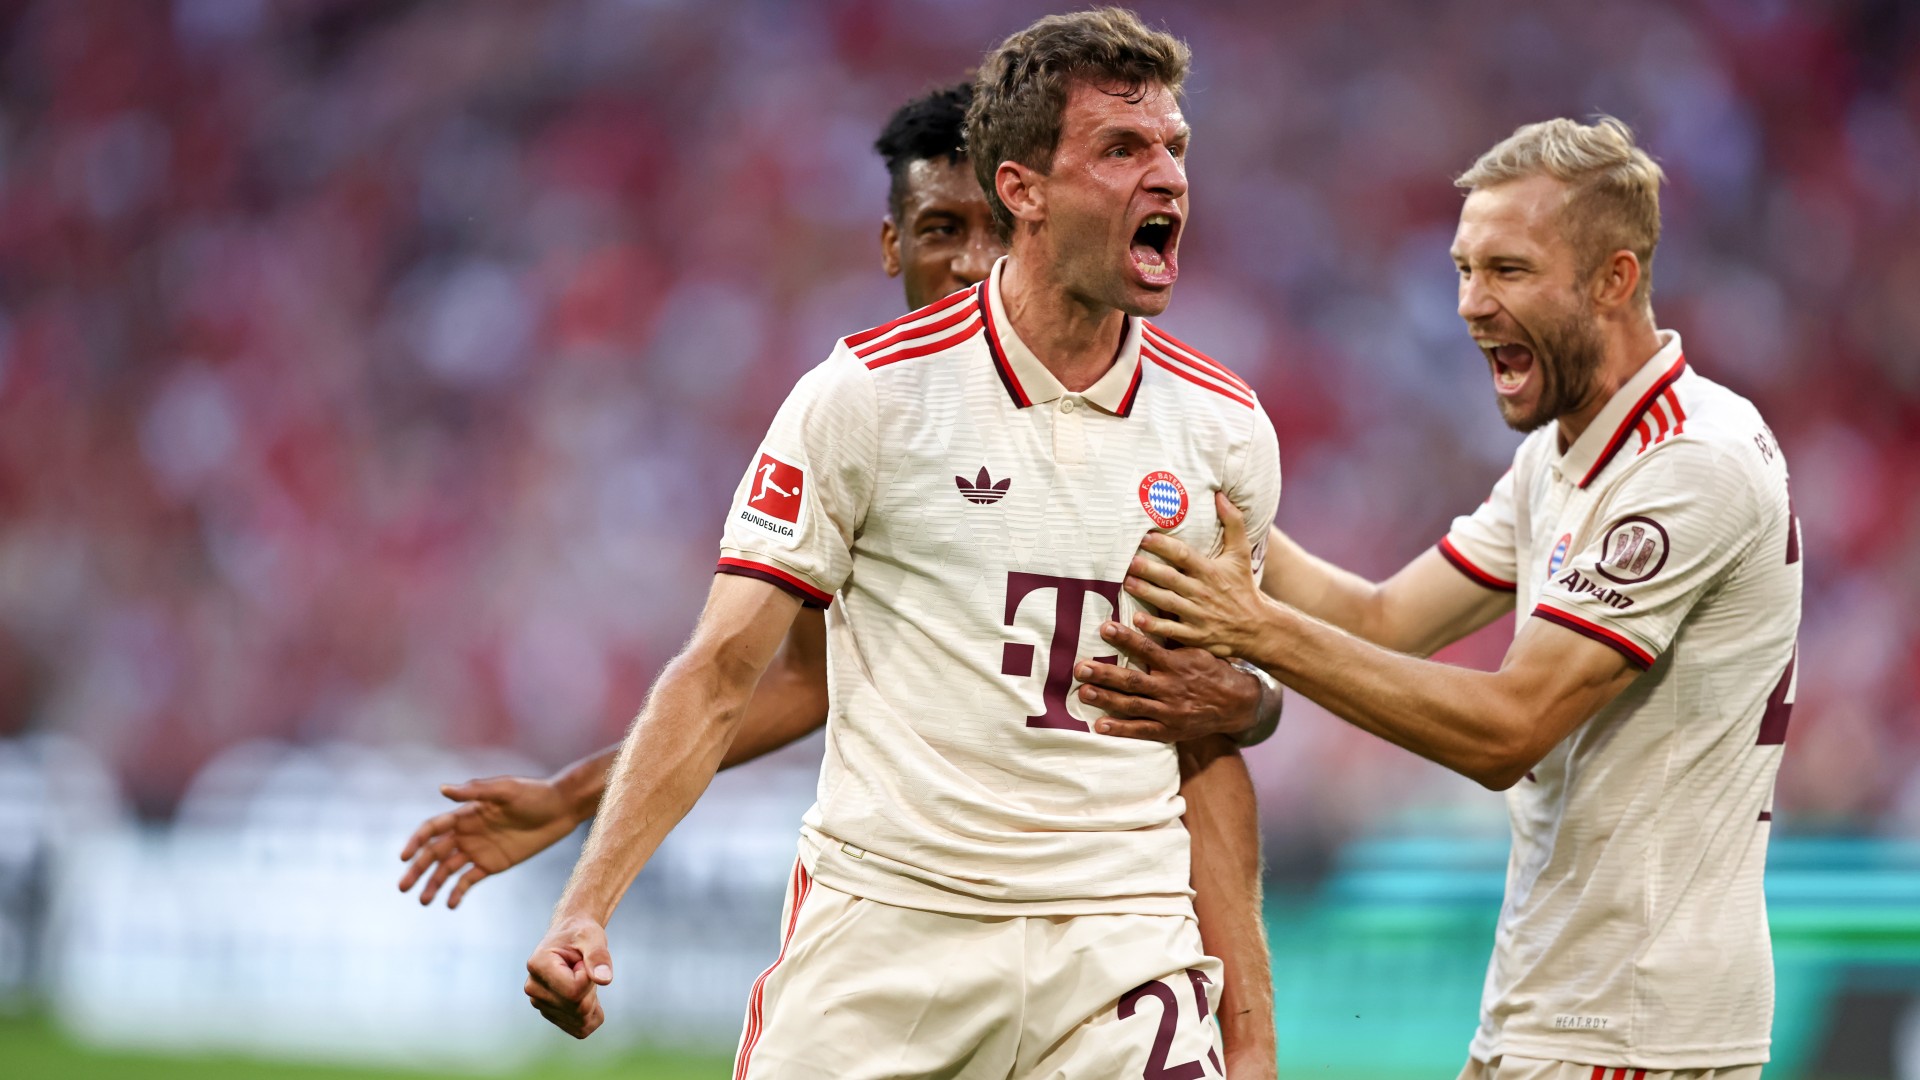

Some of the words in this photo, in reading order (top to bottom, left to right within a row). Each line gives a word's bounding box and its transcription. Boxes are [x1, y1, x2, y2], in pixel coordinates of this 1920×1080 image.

[1157, 472, 1186, 495] BAYERN
[741, 511, 794, 537] BUNDESLIGA
[1555, 1016, 1608, 1029] HEAT.RDY
